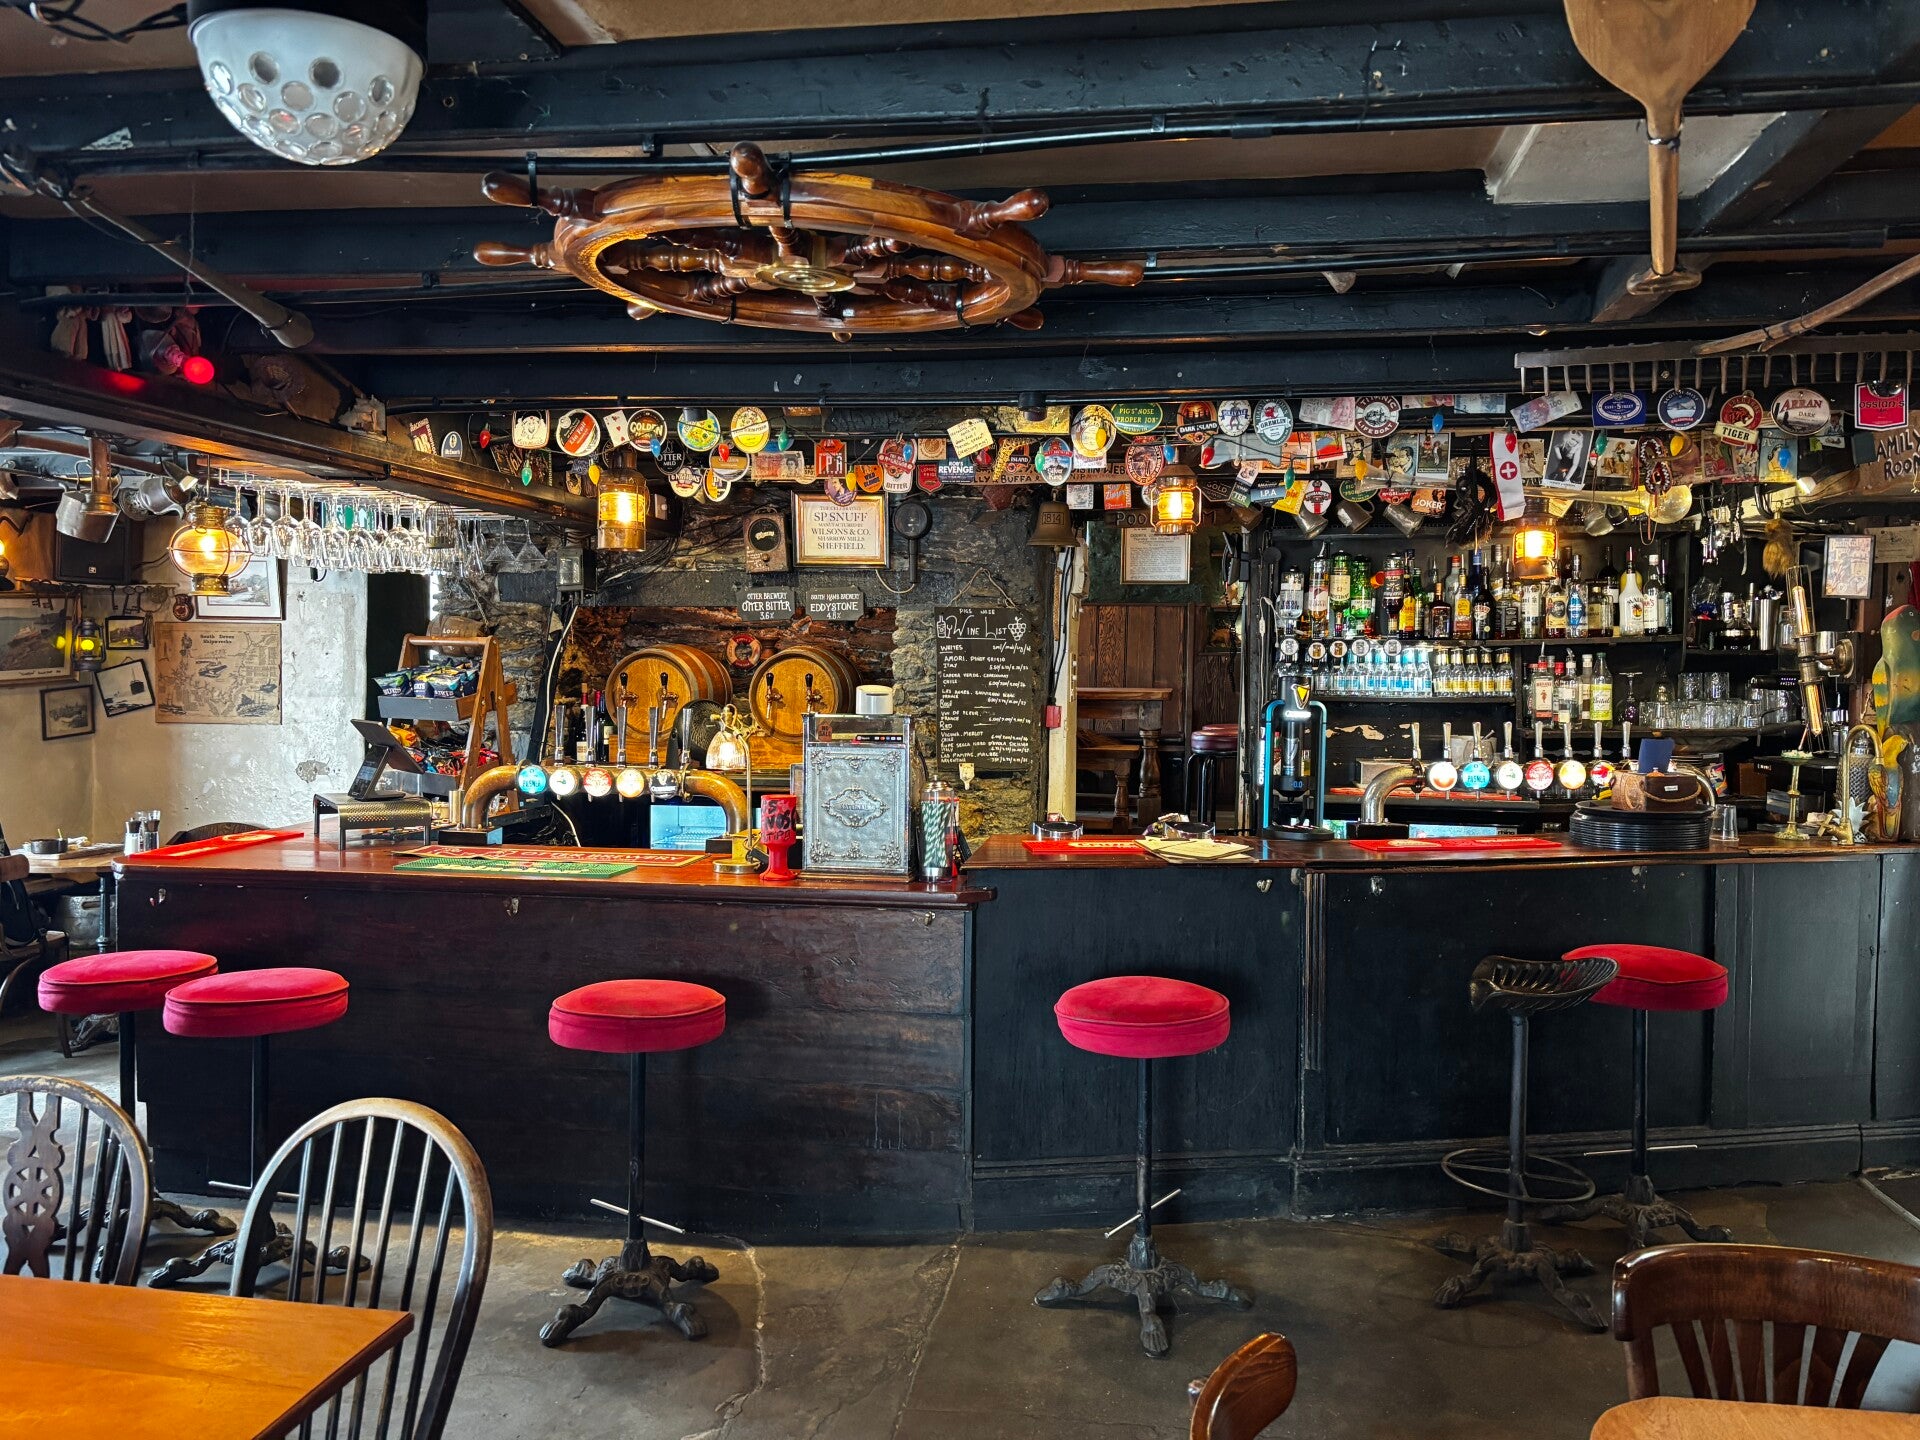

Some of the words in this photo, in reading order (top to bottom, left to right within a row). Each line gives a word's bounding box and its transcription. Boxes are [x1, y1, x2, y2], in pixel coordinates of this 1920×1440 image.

[1780, 399, 1823, 413] ARRAN
[630, 420, 664, 437] GOLDEN
[1179, 424, 1196, 434] DARK
[1196, 421, 1219, 431] ISLAND
[1260, 418, 1288, 429] GREMLIN
[1358, 420, 1394, 436] LIFEBOAT
[1721, 426, 1750, 441] TIGER
[1876, 428, 1920, 463] AMILY
[938, 465, 974, 474] REVENGE
[1414, 499, 1443, 510] JOKER
[829, 512, 868, 521] SNUFF
[811, 528, 848, 536] WILSONS
[849, 528, 856, 536] &
[857, 528, 871, 536] CO.
[817, 542, 866, 550] SHEFFIELD.
[747, 592, 763, 600] OTTER
[763, 592, 787, 600] BREWERY
[742, 601, 764, 612] OTTER
[766, 600, 791, 612] BITTER
[810, 601, 859, 612] EDDYSTONE
[945, 615, 980, 637] WINE
[984, 616, 1008, 639] LIST
